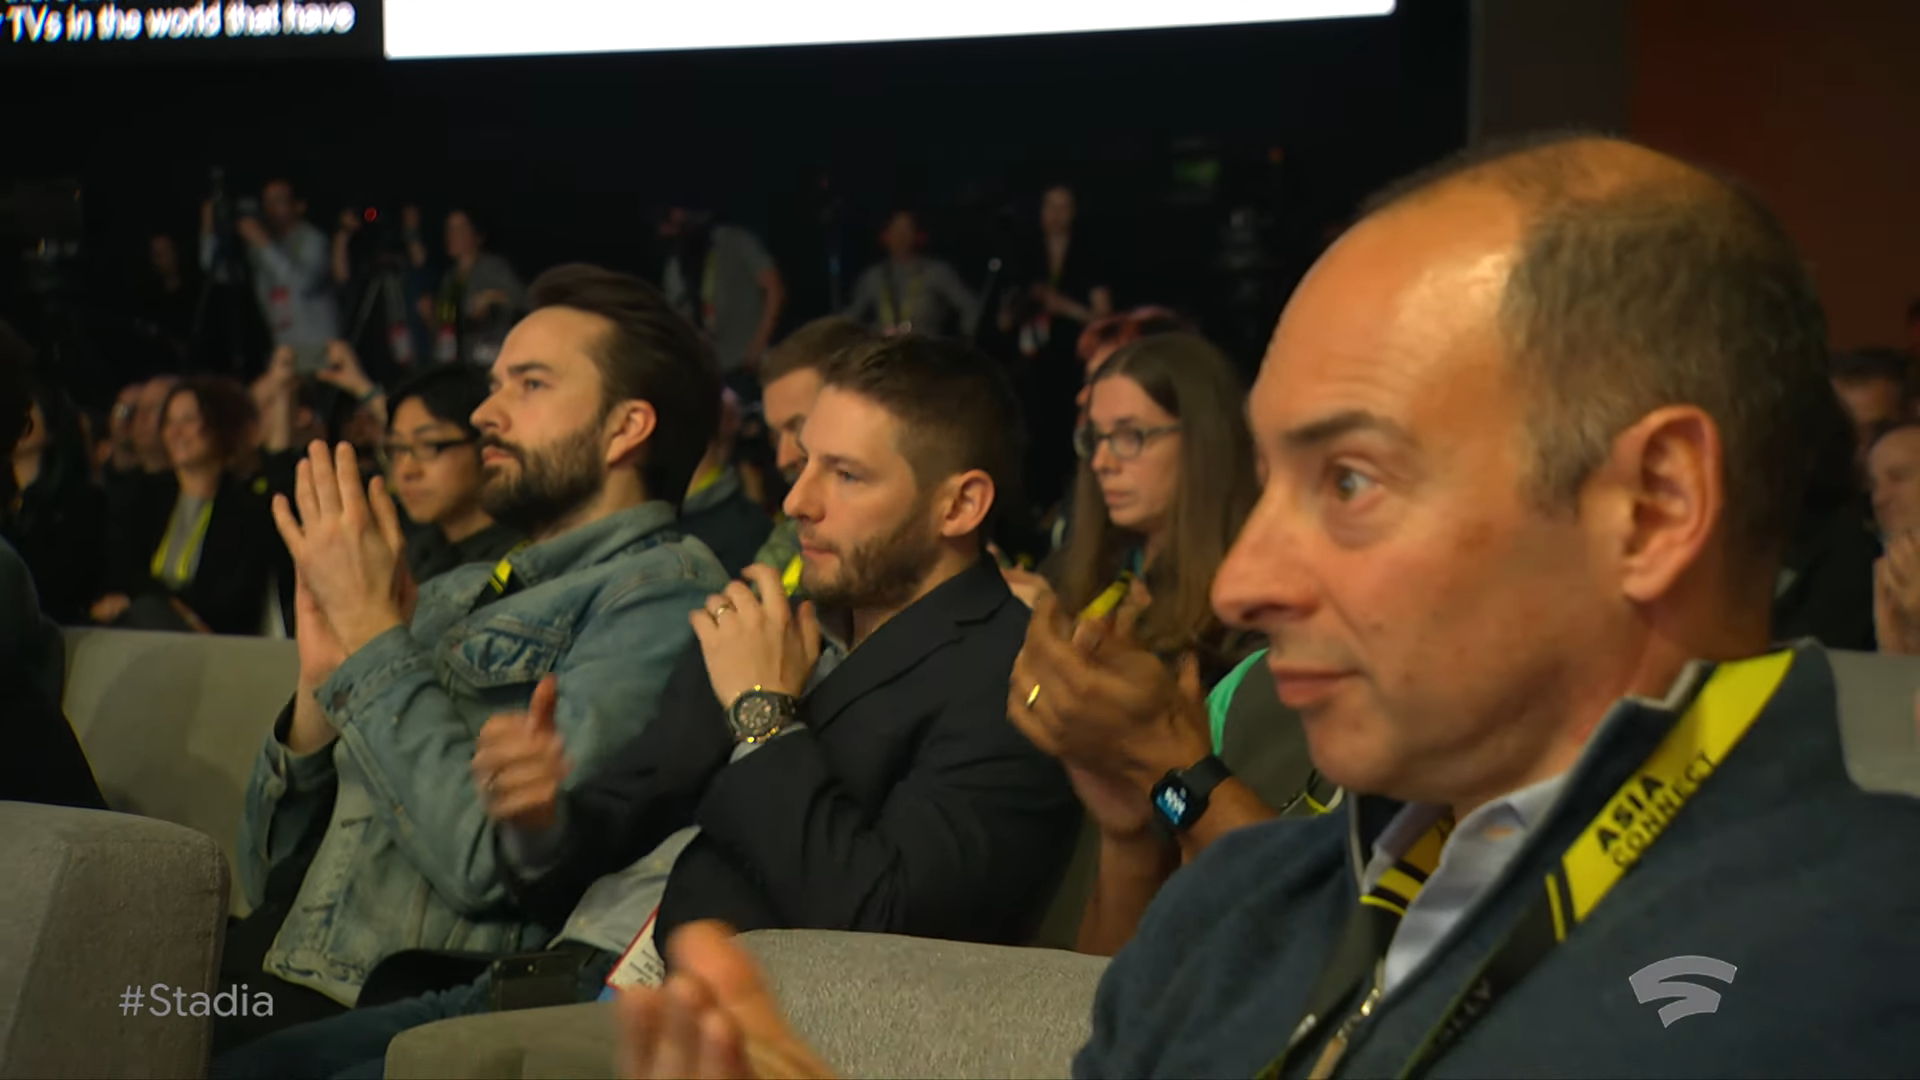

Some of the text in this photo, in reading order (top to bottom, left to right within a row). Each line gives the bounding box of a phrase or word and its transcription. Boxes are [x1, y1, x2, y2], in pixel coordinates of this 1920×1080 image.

[6, 4, 62, 42] TVs
[66, 3, 94, 41] in
[97, 2, 142, 40] the
[145, 0, 221, 38] world
[224, 0, 281, 37] that
[282, 0, 355, 34] have
[1597, 774, 1664, 854] ASIA
[1612, 752, 1718, 868] CONNECT
